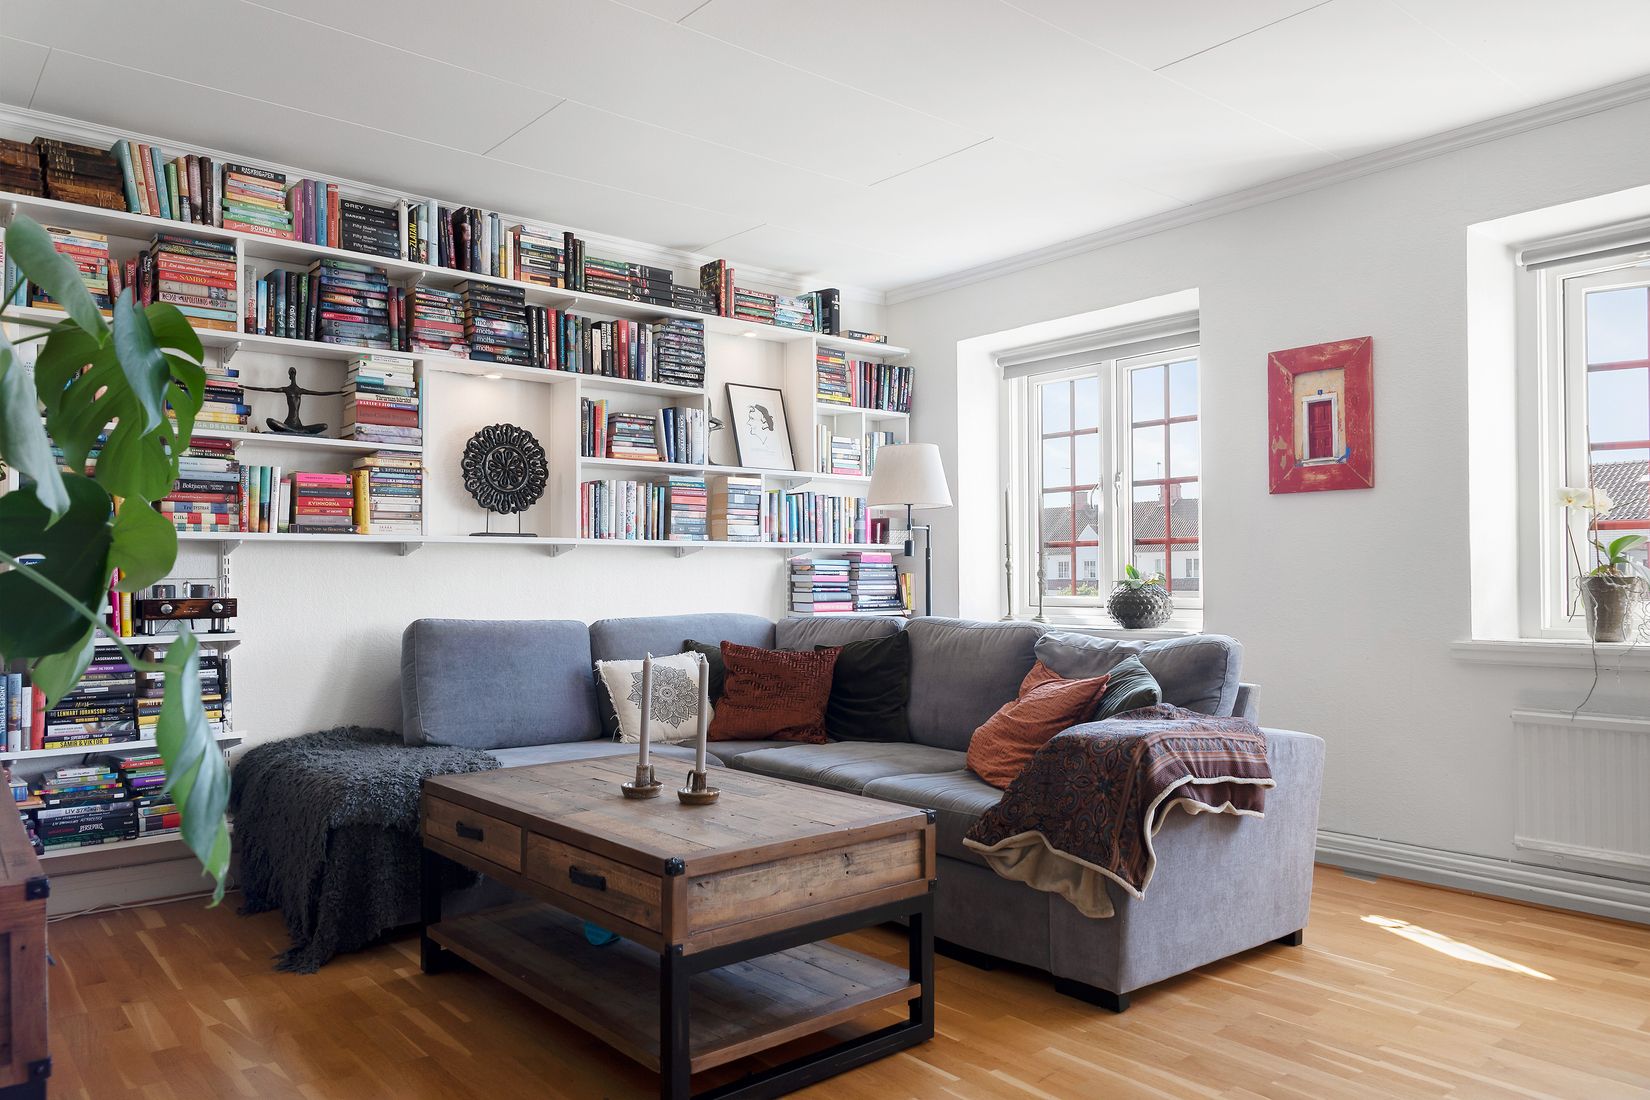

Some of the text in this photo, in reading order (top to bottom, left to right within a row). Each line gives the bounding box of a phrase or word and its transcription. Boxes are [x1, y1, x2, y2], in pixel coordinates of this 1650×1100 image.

[344, 202, 364, 210] GREY
[180, 274, 206, 284] SAMBO
[57, 708, 106, 717] LENNART JOHANSSON
[84, 738, 103, 746] VIKTOR
